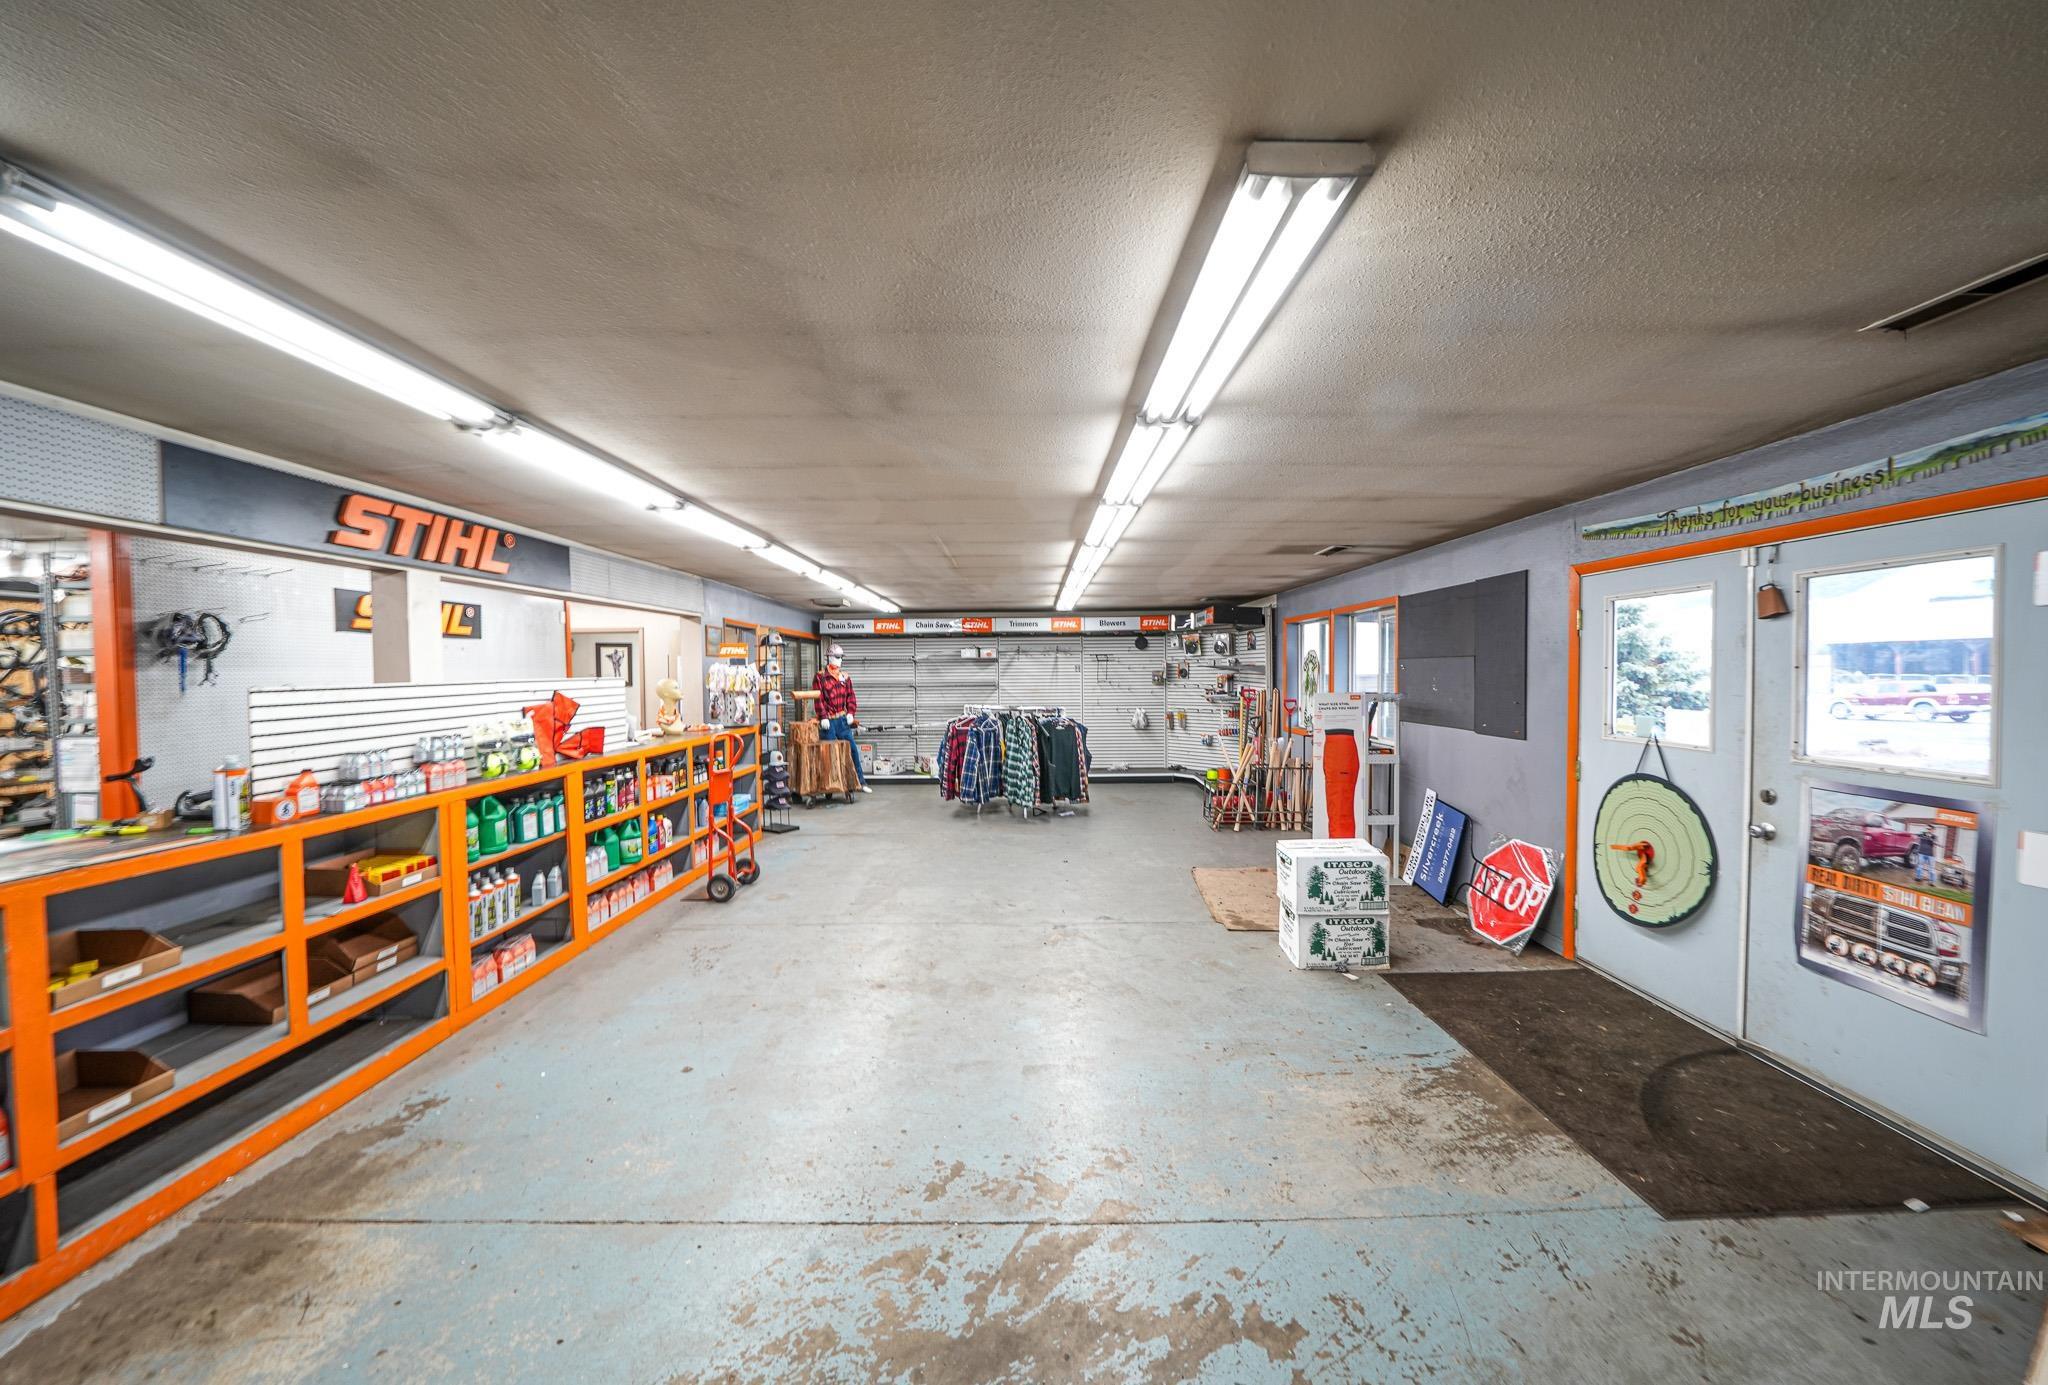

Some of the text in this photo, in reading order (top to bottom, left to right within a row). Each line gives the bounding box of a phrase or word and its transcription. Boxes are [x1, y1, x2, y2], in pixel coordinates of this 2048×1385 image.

[1657, 456, 1894, 530] Thanks for your business!
[330, 492, 512, 576] STIHL
[827, 622, 865, 630] Chain Saws
[875, 621, 901, 630] STIHL
[915, 621, 934, 629] Chain
[1009, 620, 1039, 628] Trimmers
[1053, 619, 1079, 629] STIHL
[1099, 619, 1126, 627] Blowers
[1141, 619, 1168, 627] STIHL
[719, 646, 747, 655] STIHL
[1420, 813, 1444, 882] Silvercreek
[1475, 864, 1544, 917] STOP
[1882, 884, 1918, 911] STIHL
[1328, 917, 1370, 925] ITASCA
